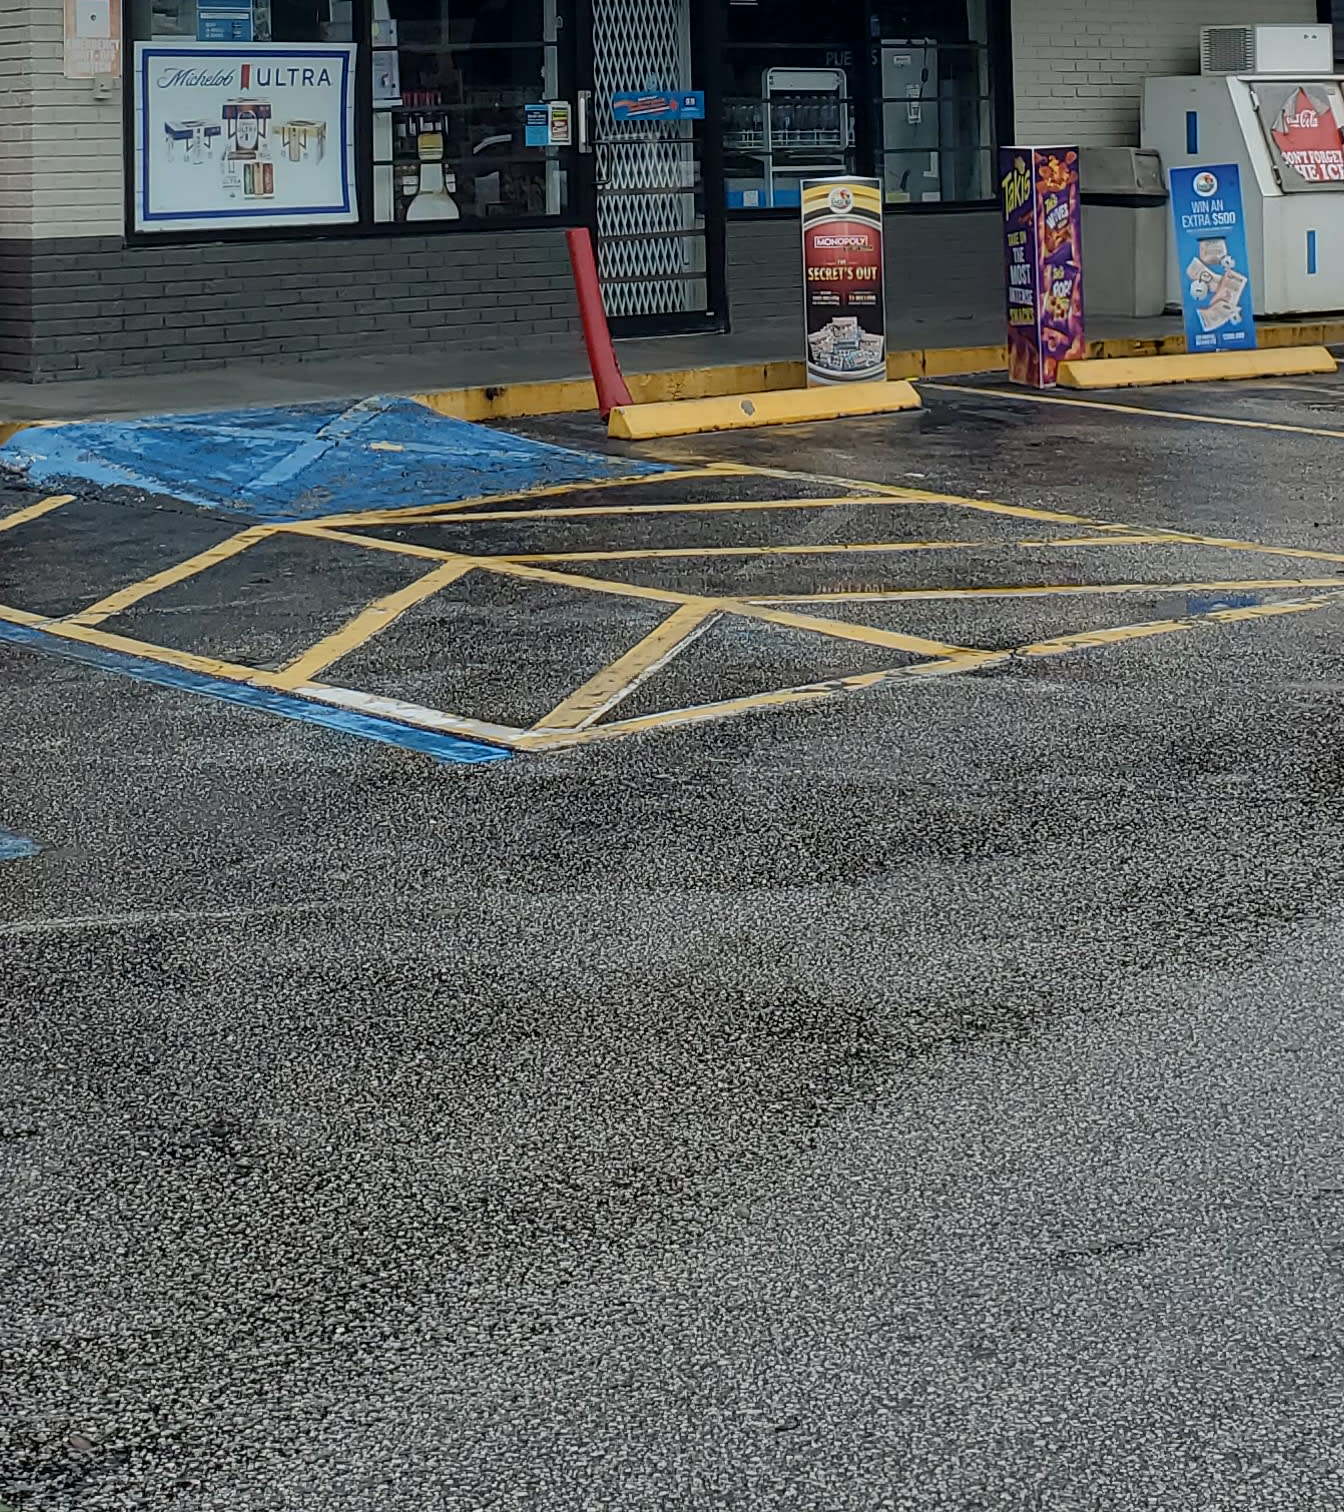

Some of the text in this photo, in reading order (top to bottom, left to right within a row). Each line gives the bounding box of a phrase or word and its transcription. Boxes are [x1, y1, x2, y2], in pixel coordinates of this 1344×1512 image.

[157, 67, 332, 89] Michelob ULTRA
[1308, 149, 1343, 163] FORGET
[1001, 169, 1031, 222] Takis
[1191, 199, 1224, 214] WIN AN
[1182, 211, 1236, 229] EXTRA $500
[816, 237, 866, 247] MONOPOLY
[807, 266, 878, 281] SECRET'S OUT
[1009, 264, 1031, 286] MOST
